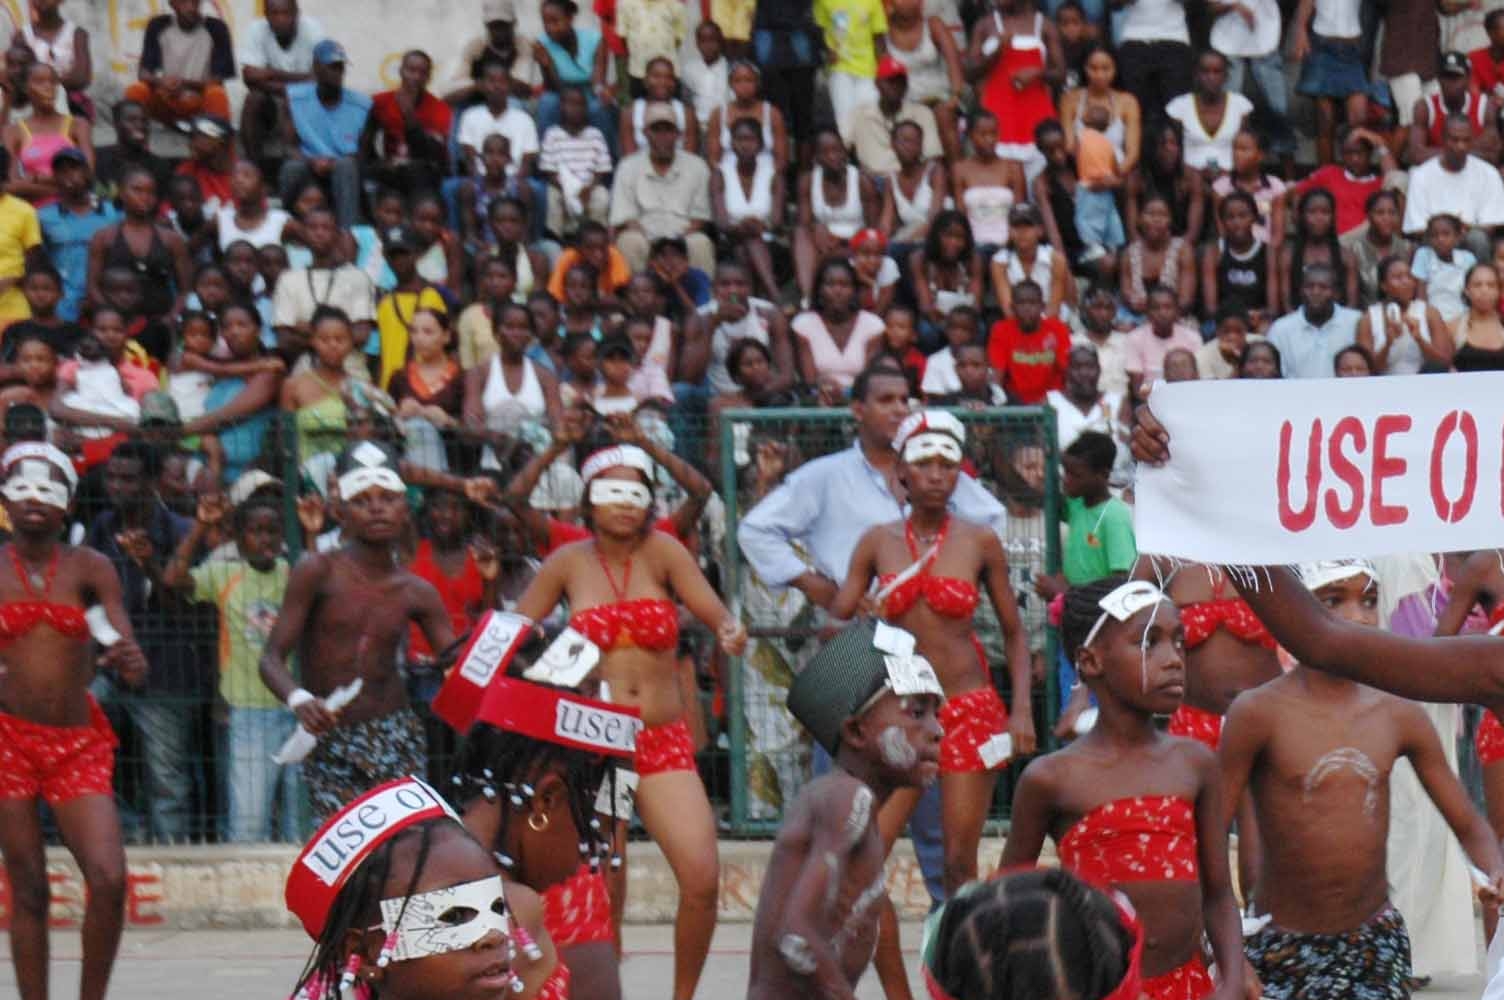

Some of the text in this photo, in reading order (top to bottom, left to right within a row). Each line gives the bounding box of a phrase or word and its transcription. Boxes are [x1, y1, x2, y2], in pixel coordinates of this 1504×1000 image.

[1277, 414, 1412, 532] USE
[1430, 410, 1479, 523] O
[465, 626, 511, 677] use
[560, 704, 622, 744] use
[311, 804, 387, 871] use
